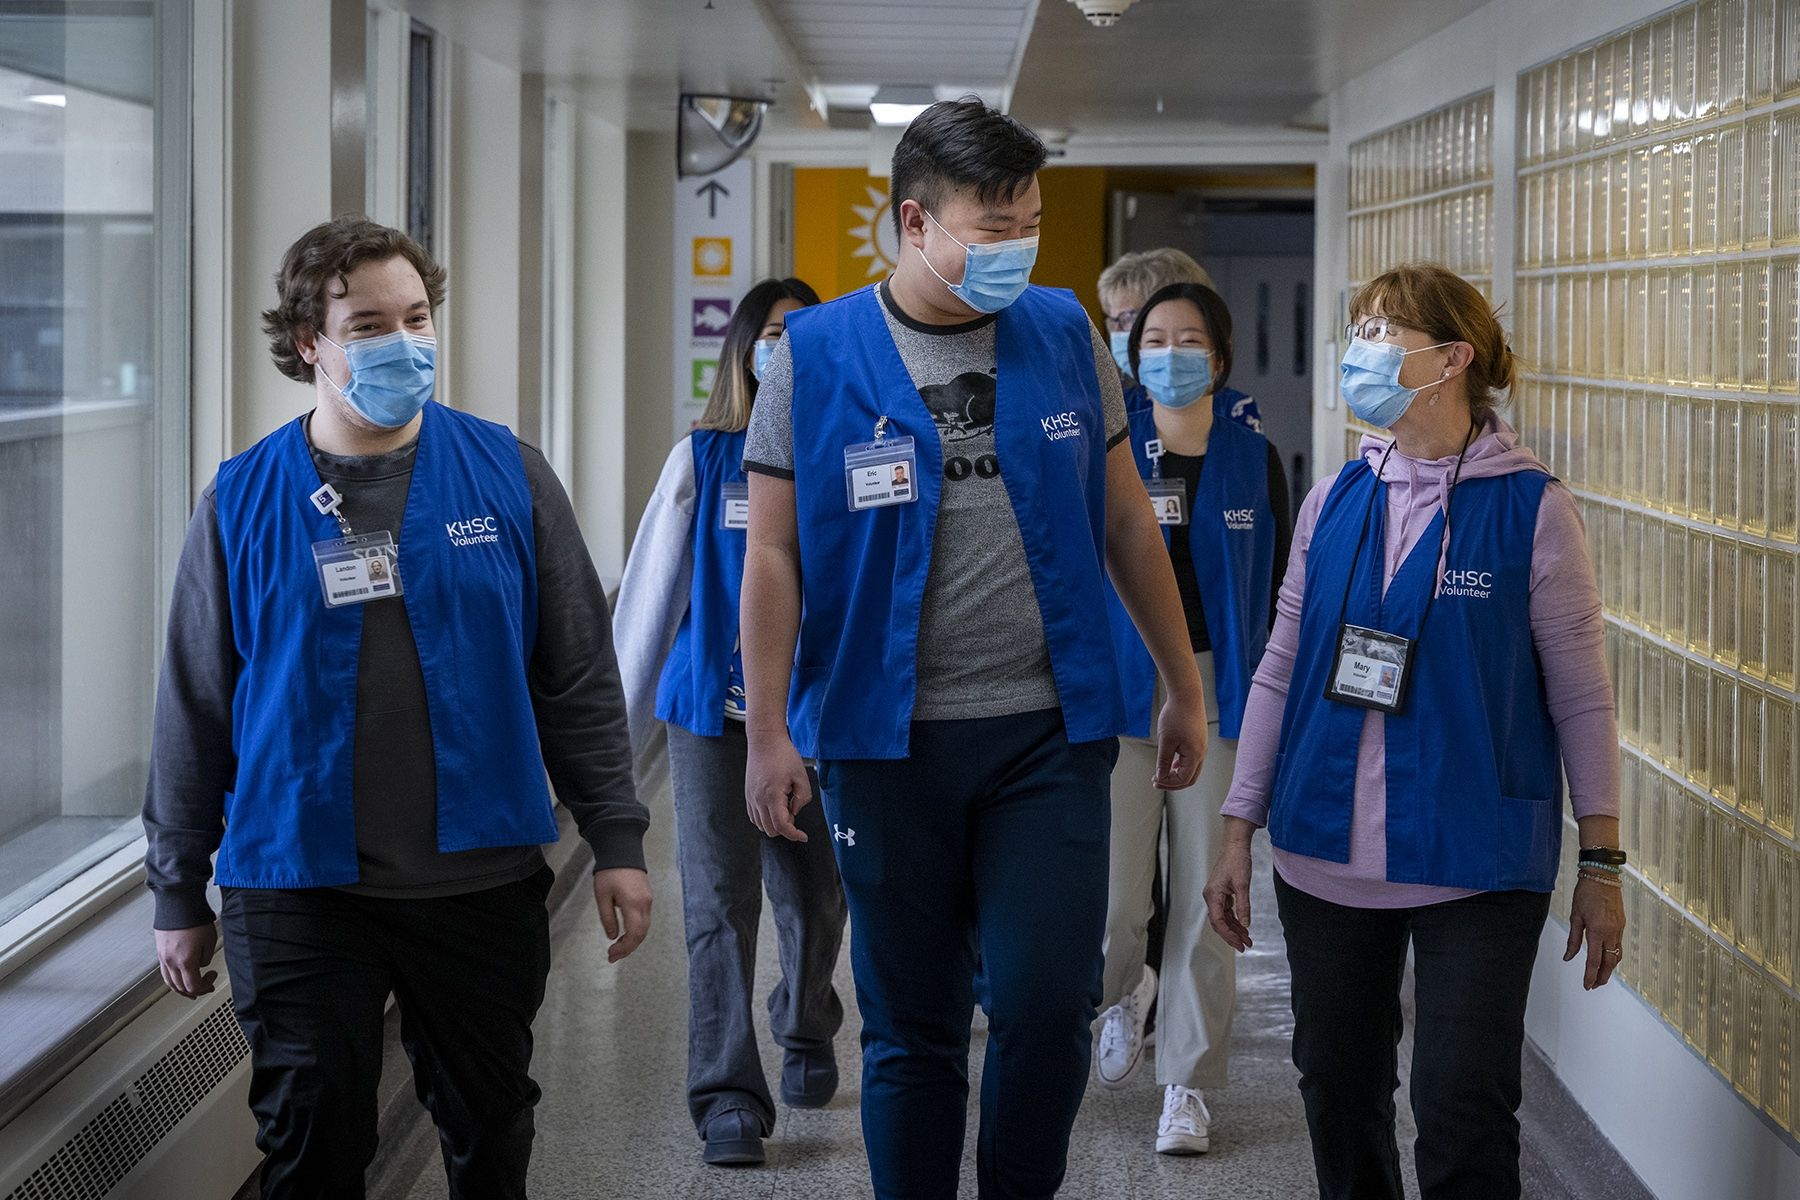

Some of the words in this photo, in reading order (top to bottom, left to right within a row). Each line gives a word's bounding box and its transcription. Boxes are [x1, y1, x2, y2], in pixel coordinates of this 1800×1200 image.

[1041, 411, 1079, 432] KHSC
[1046, 428, 1081, 441] Volunteer
[1223, 508, 1254, 522] KHSC
[446, 516, 497, 537] KHSC
[451, 534, 498, 547] Volunteer
[335, 564, 356, 573] Landon
[1440, 585, 1491, 598] Volunteer
[1353, 661, 1371, 674] Mary
